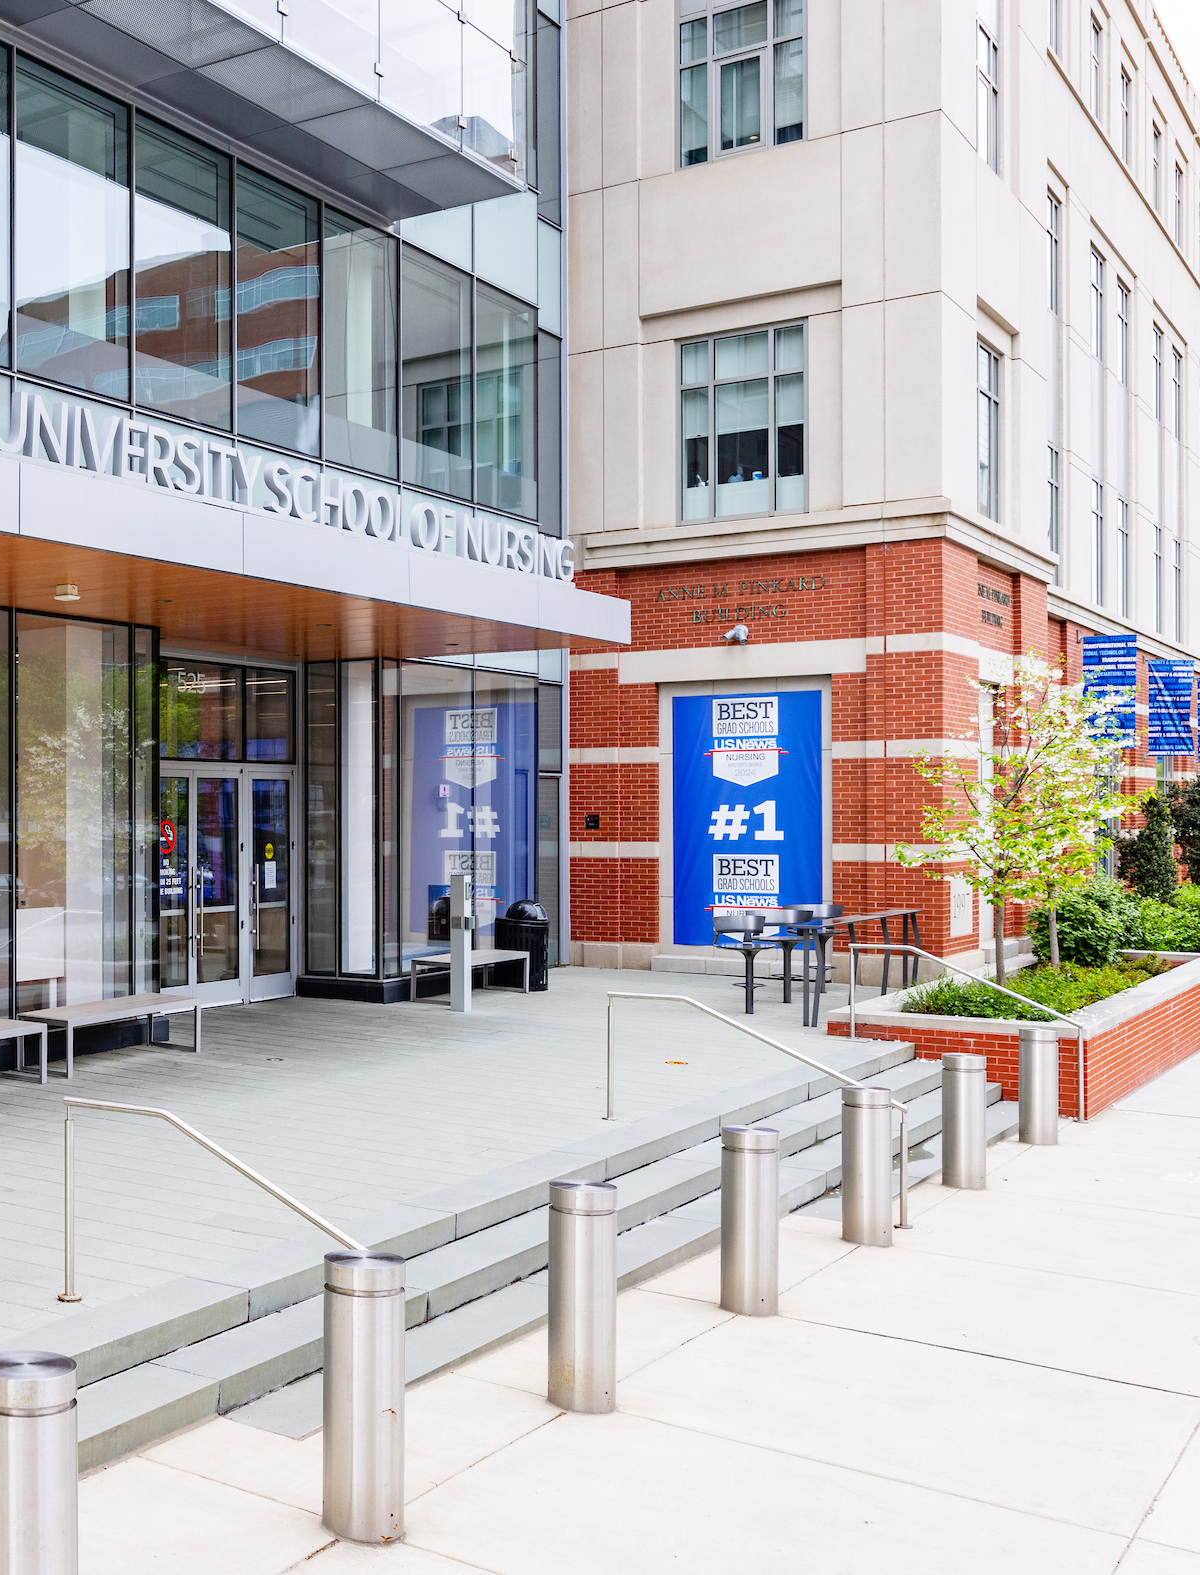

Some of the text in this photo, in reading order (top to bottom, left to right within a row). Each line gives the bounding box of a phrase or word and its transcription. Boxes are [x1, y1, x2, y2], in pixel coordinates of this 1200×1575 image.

[263, 460, 410, 546] SCHOOL
[410, 501, 457, 552] OF
[457, 512, 575, 582] NURSING
[655, 575, 826, 602] ANNE M. PINKARD
[692, 603, 786, 624] BUILDING
[178, 671, 206, 694] 525
[717, 701, 774, 721] BEST
[717, 720, 774, 735] GRAD SCHOOLS
[726, 752, 766, 761] NURSING
[734, 768, 756, 777] 2024
[708, 800, 785, 841] #1
[160, 868, 176, 876] MOKING
[717, 858, 775, 877] BEST
[717, 877, 775, 892] GRAD SCHOOLS
